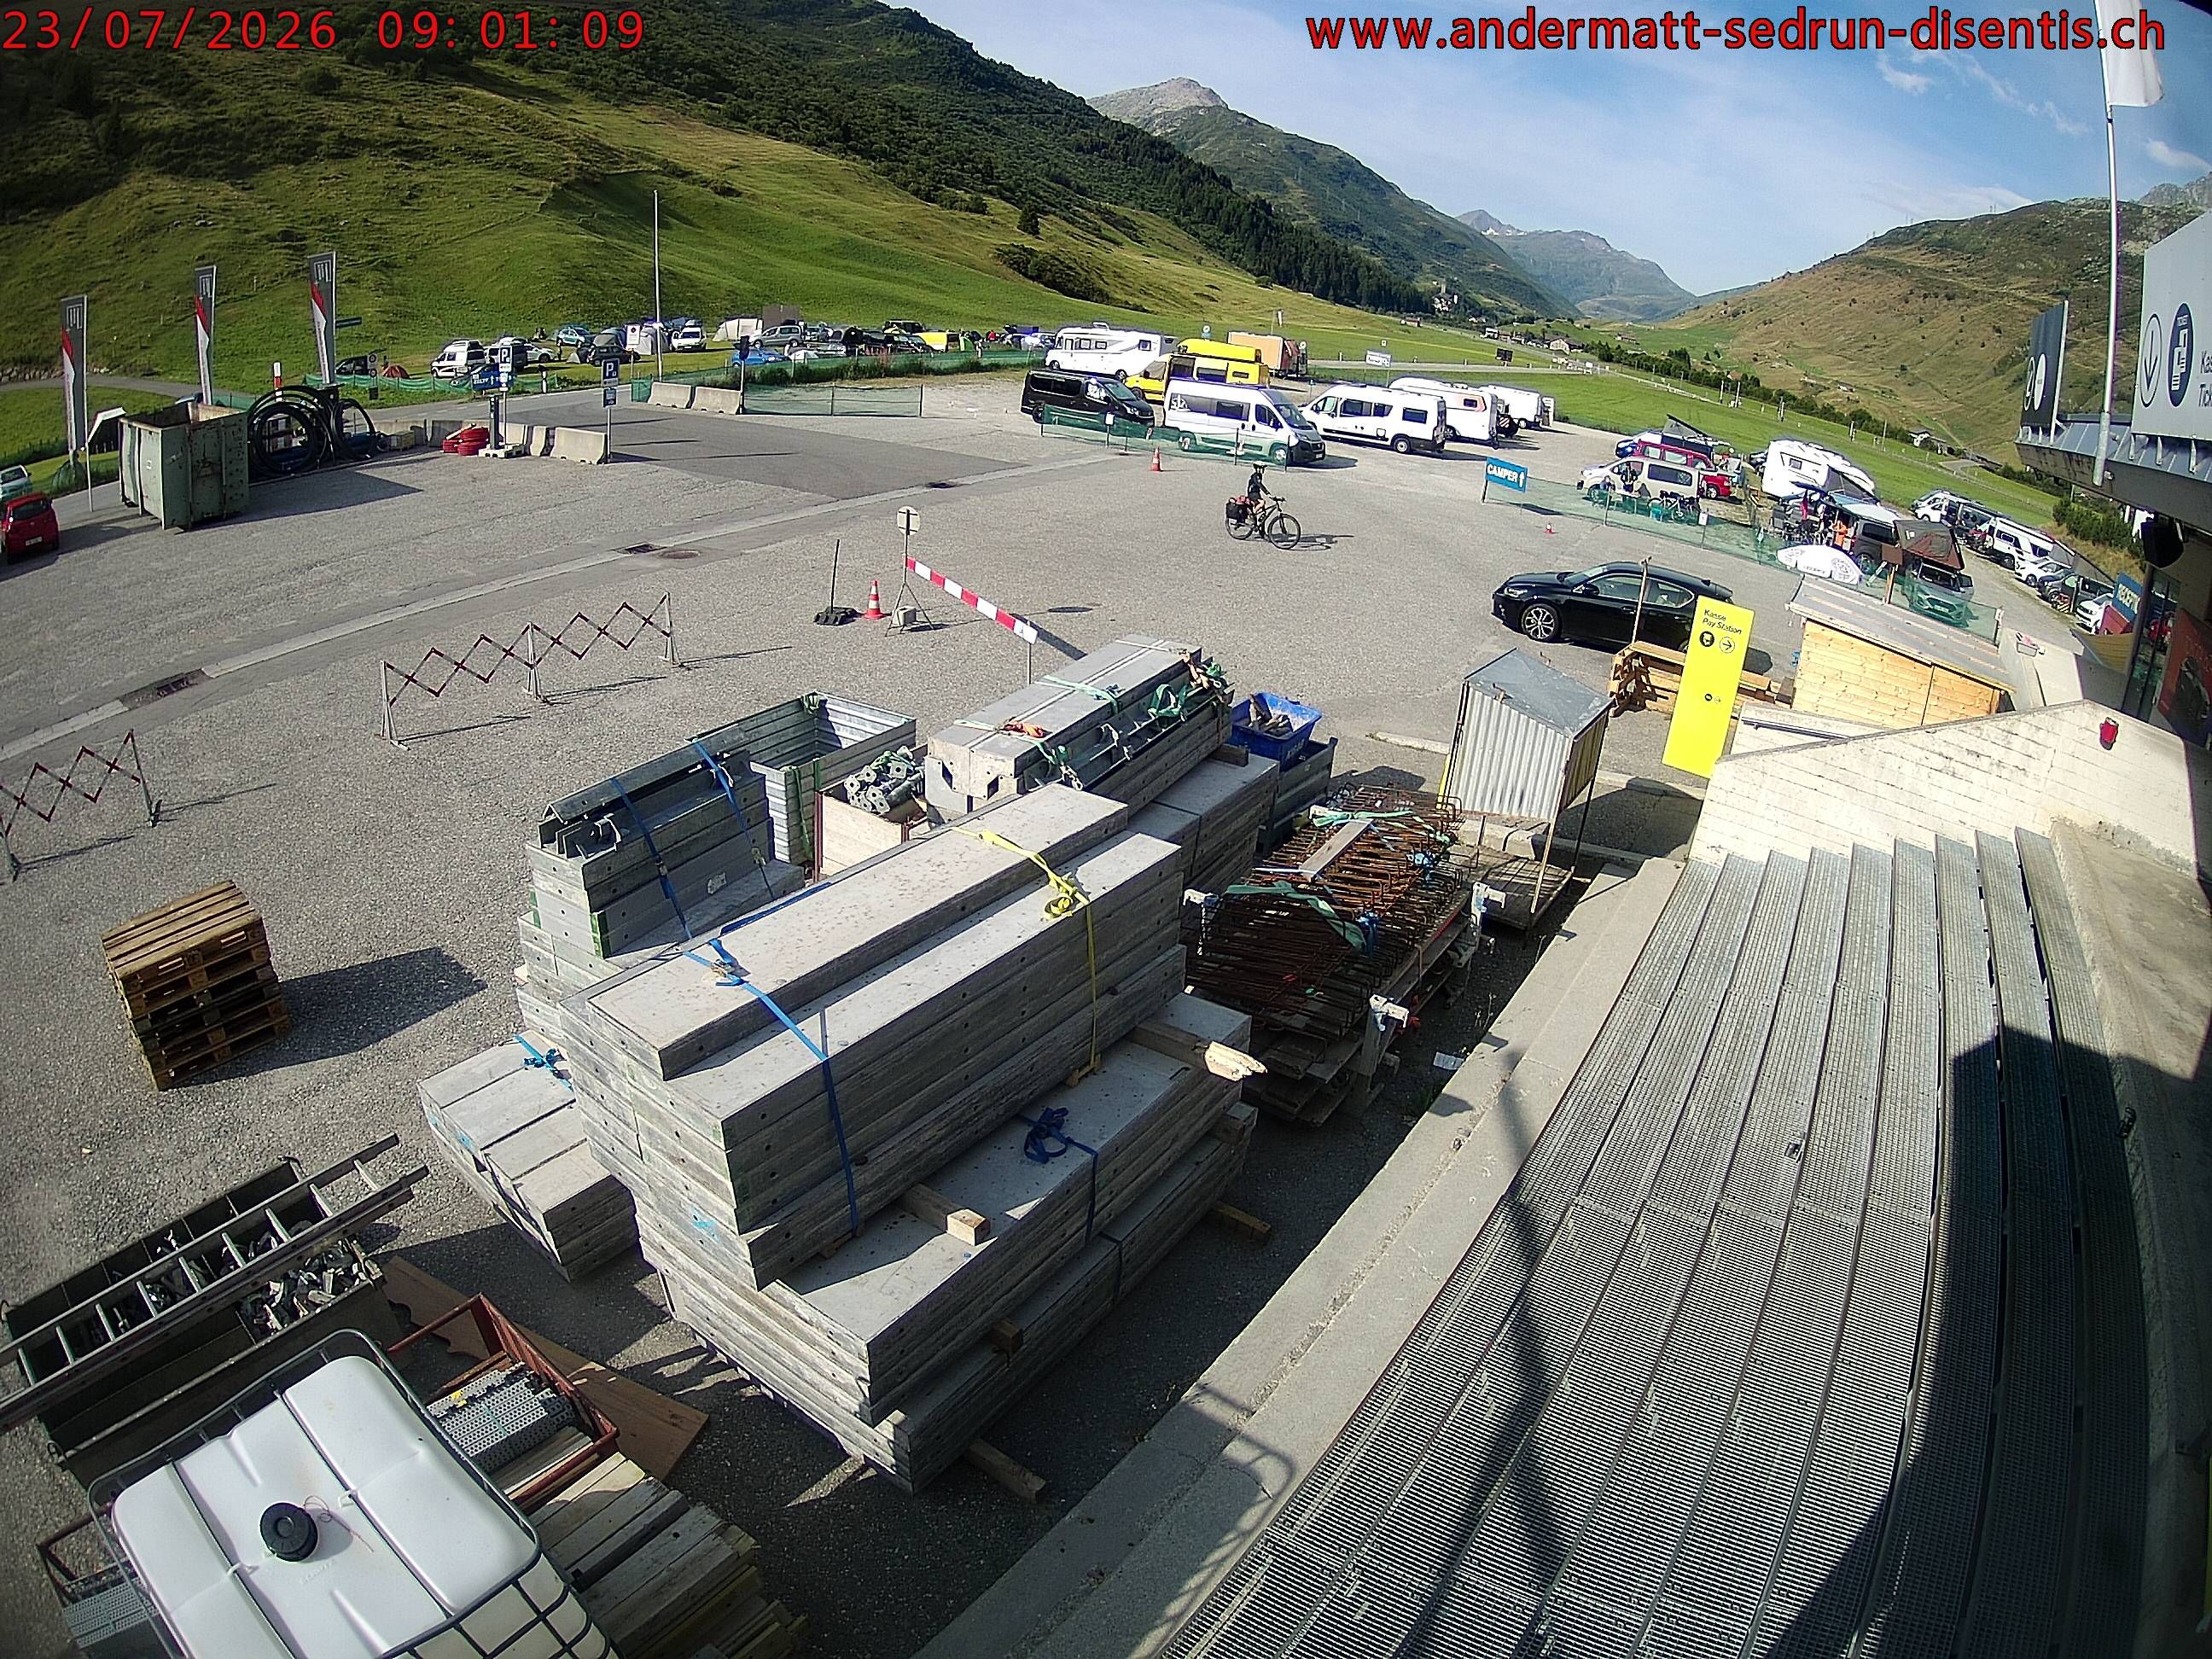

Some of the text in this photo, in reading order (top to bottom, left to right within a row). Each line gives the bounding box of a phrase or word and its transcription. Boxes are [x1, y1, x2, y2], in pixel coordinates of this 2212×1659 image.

[501, 348, 509, 363] P
[606, 362, 614, 377] P
[1487, 463, 1519, 484] CAMPER
[1703, 608, 1726, 621] Kasse
[1702, 617, 1743, 635] Pay Station
